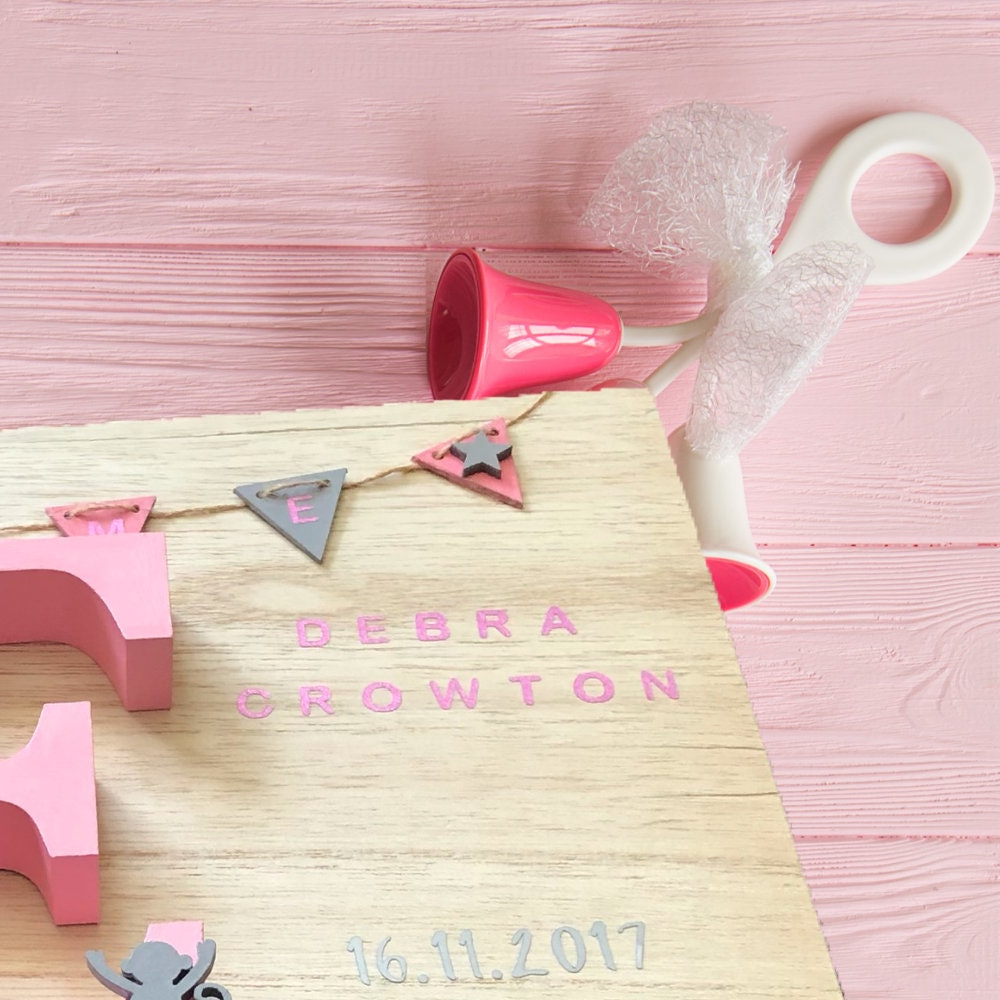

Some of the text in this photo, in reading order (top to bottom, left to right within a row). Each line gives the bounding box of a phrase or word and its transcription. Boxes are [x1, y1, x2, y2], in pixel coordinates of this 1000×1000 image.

[296, 605, 578, 648] DEBRA
[236, 669, 681, 719] CROWTON
[346, 920, 646, 986] 16.11.2017
